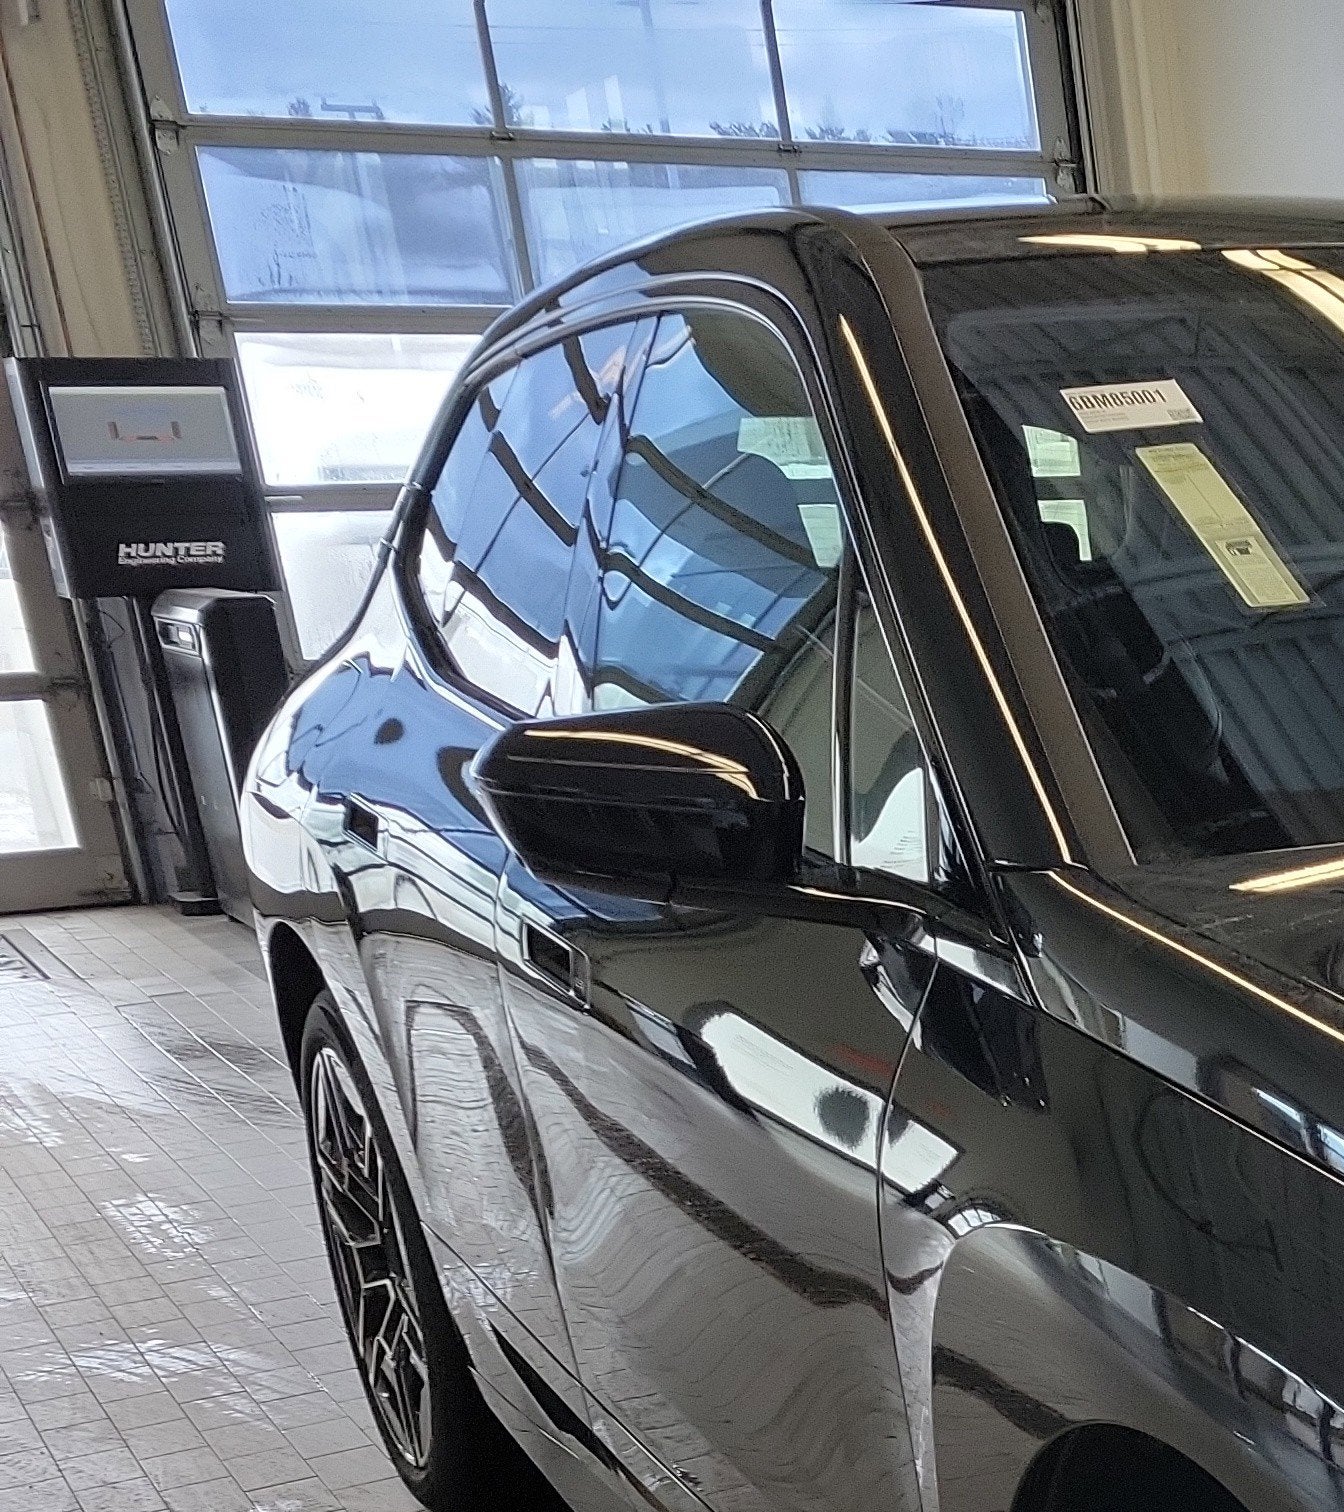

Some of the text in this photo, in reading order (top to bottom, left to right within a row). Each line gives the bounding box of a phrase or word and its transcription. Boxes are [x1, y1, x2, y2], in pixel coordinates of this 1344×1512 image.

[118, 541, 226, 557] HUNTER
[118, 555, 224, 566] Engineering Company
